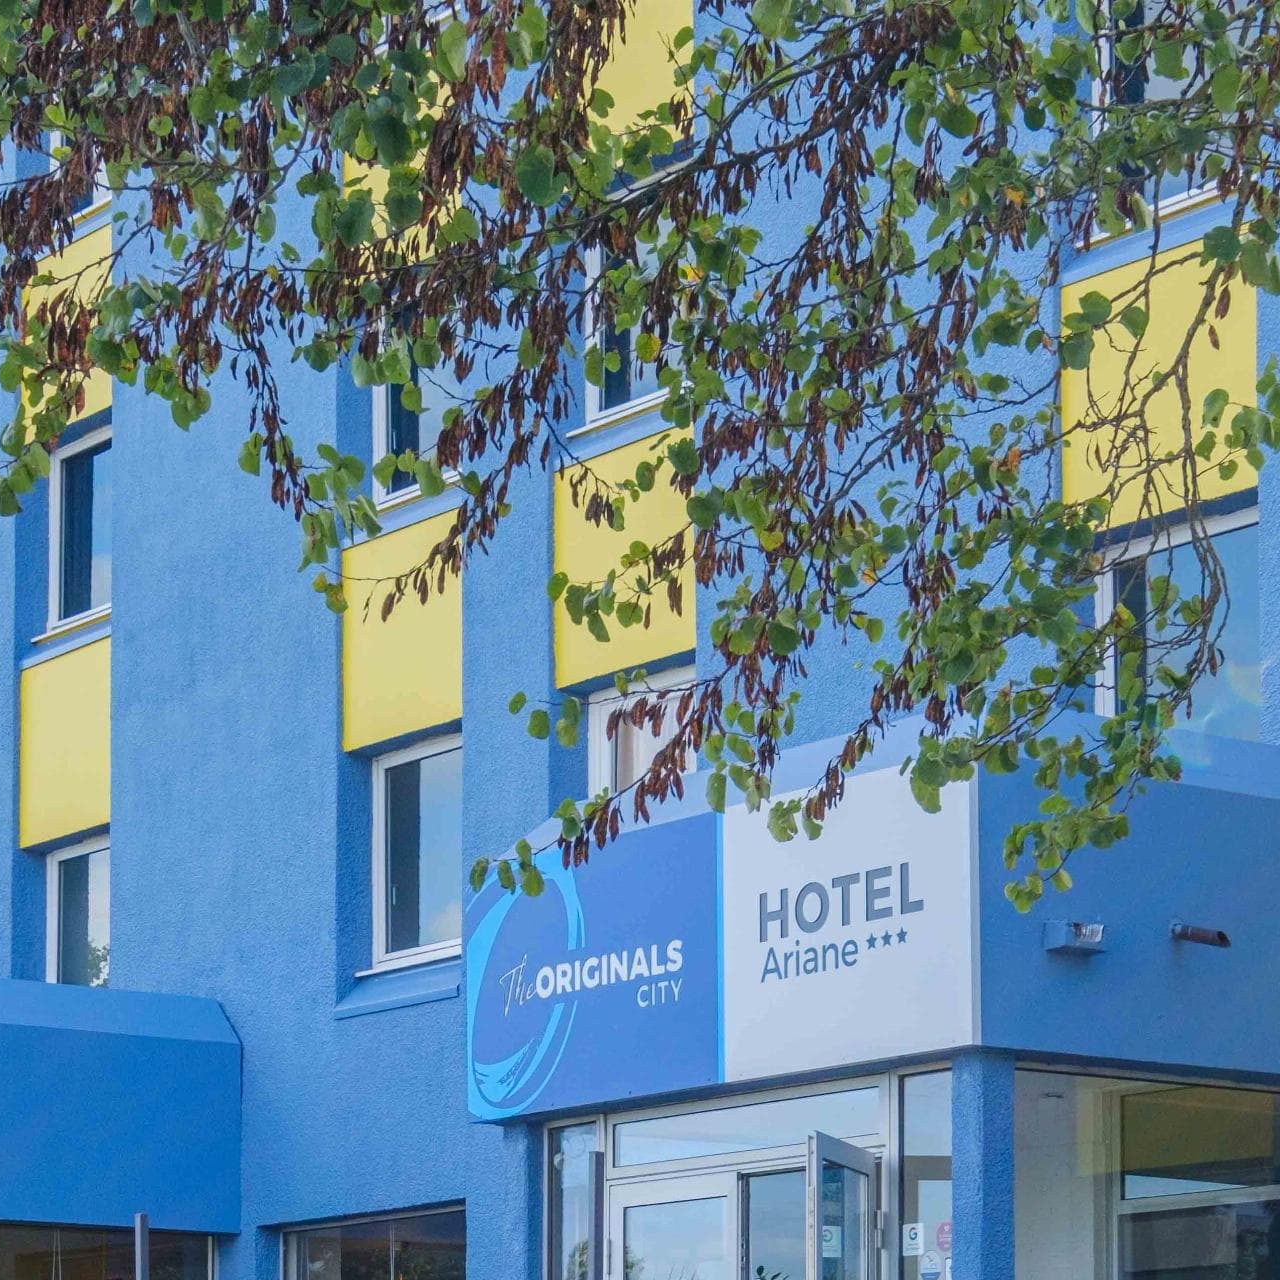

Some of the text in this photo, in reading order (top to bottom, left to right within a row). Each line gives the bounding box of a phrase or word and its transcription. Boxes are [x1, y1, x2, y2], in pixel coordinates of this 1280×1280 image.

[759, 861, 924, 943] HOTEL
[499, 939, 683, 1017] The ORIGINALS
[760, 939, 859, 984] Ariane
[635, 978, 683, 1008] CITY
